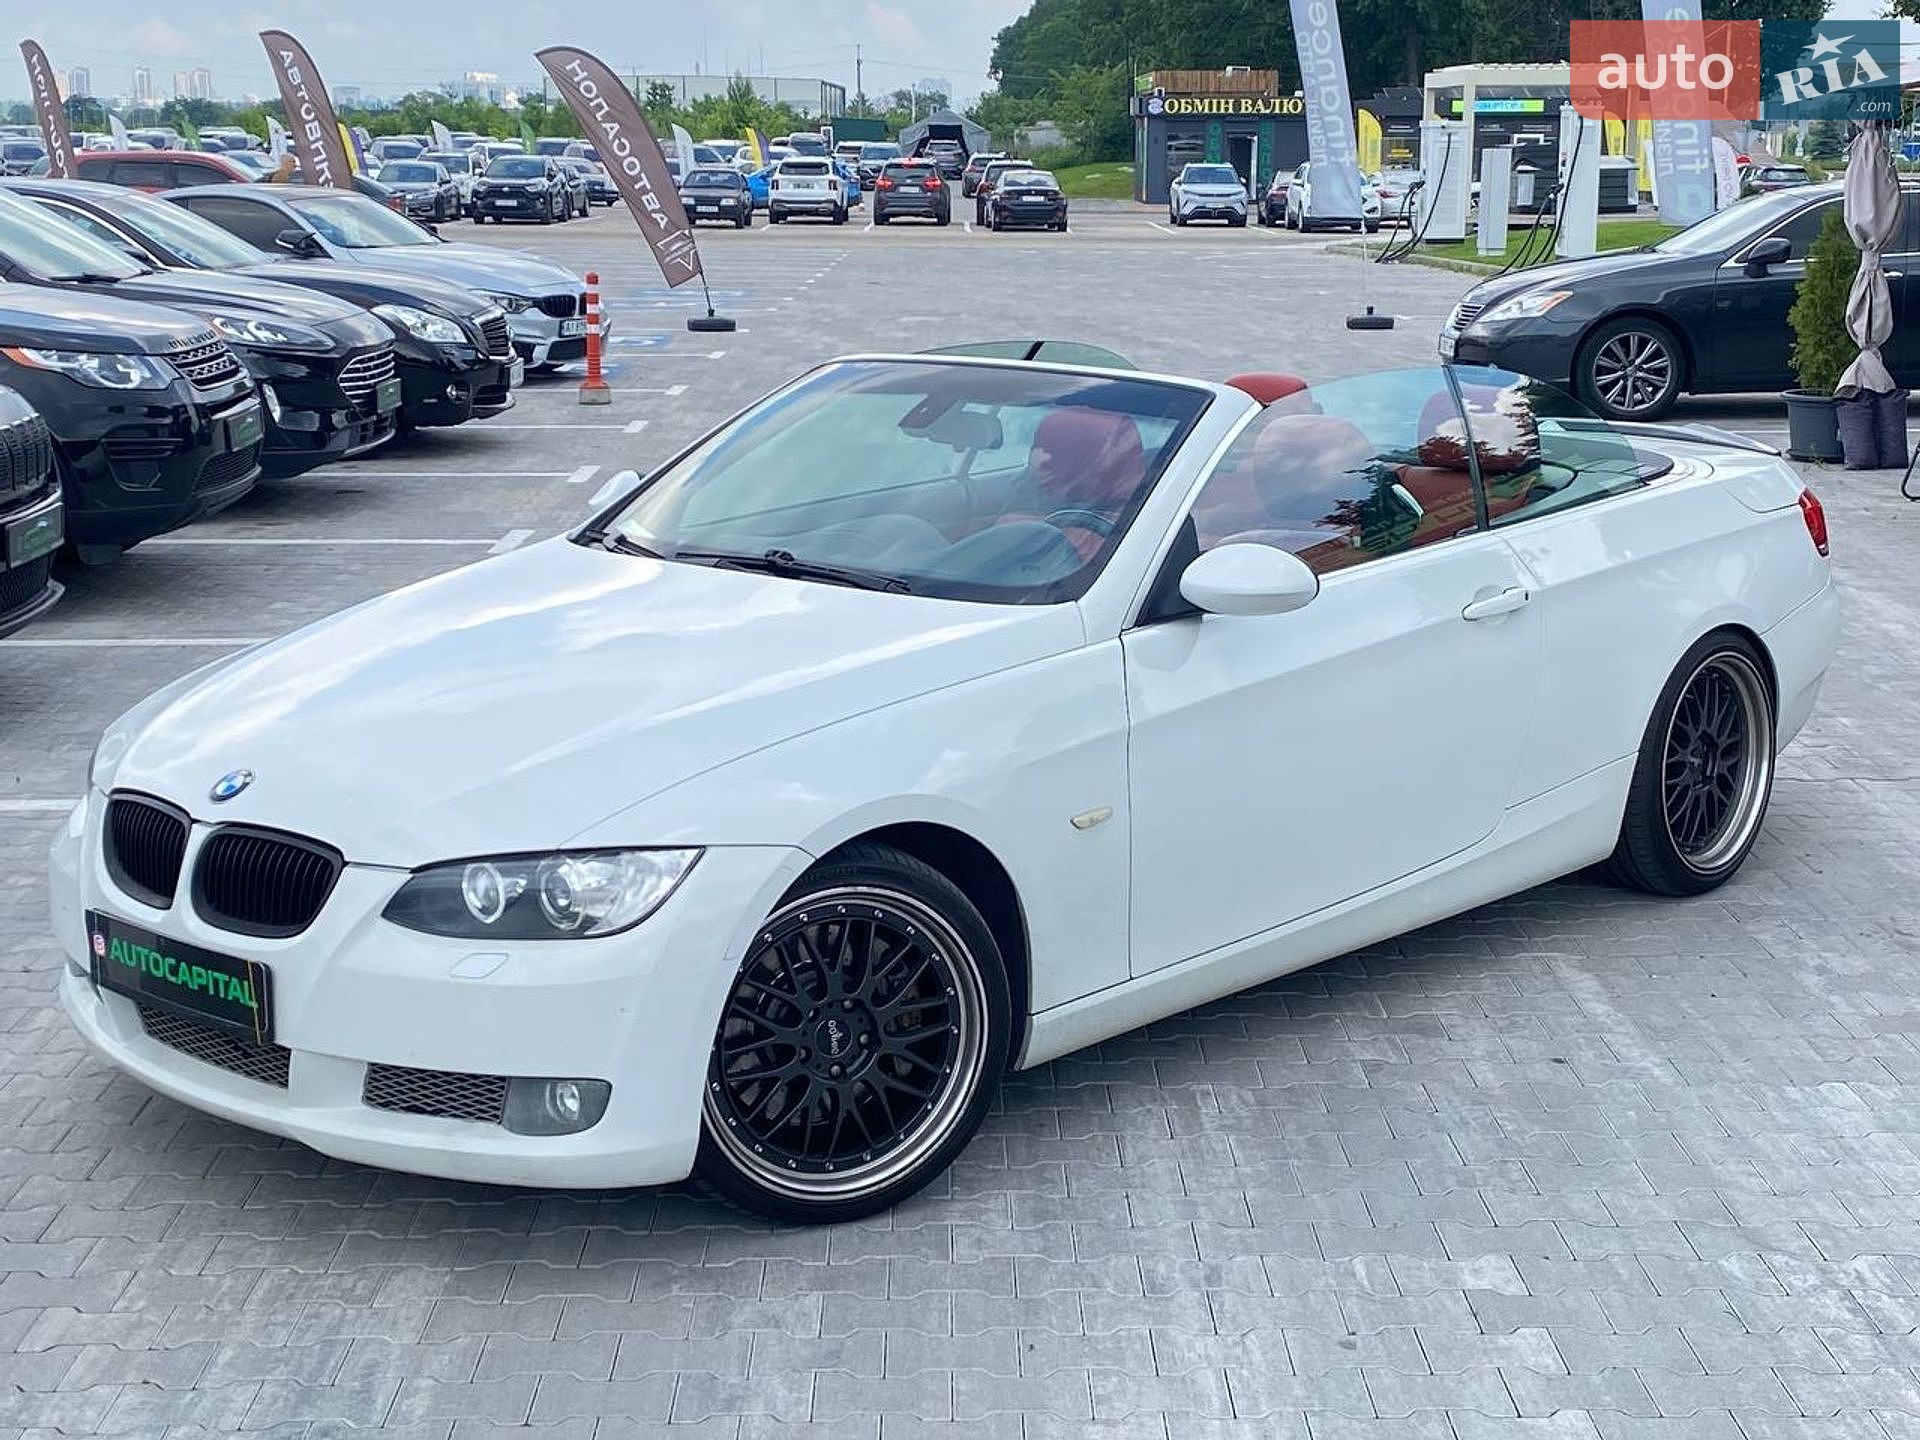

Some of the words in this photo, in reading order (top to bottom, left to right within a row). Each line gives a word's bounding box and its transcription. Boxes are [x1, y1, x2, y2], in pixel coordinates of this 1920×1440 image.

[279, 50, 334, 189] АВТОВИК
[1164, 98, 1234, 114] ОБМІН
[1240, 98, 1305, 114] ВАЛЮ
[110, 937, 259, 1009] AUTOCAPITAL
